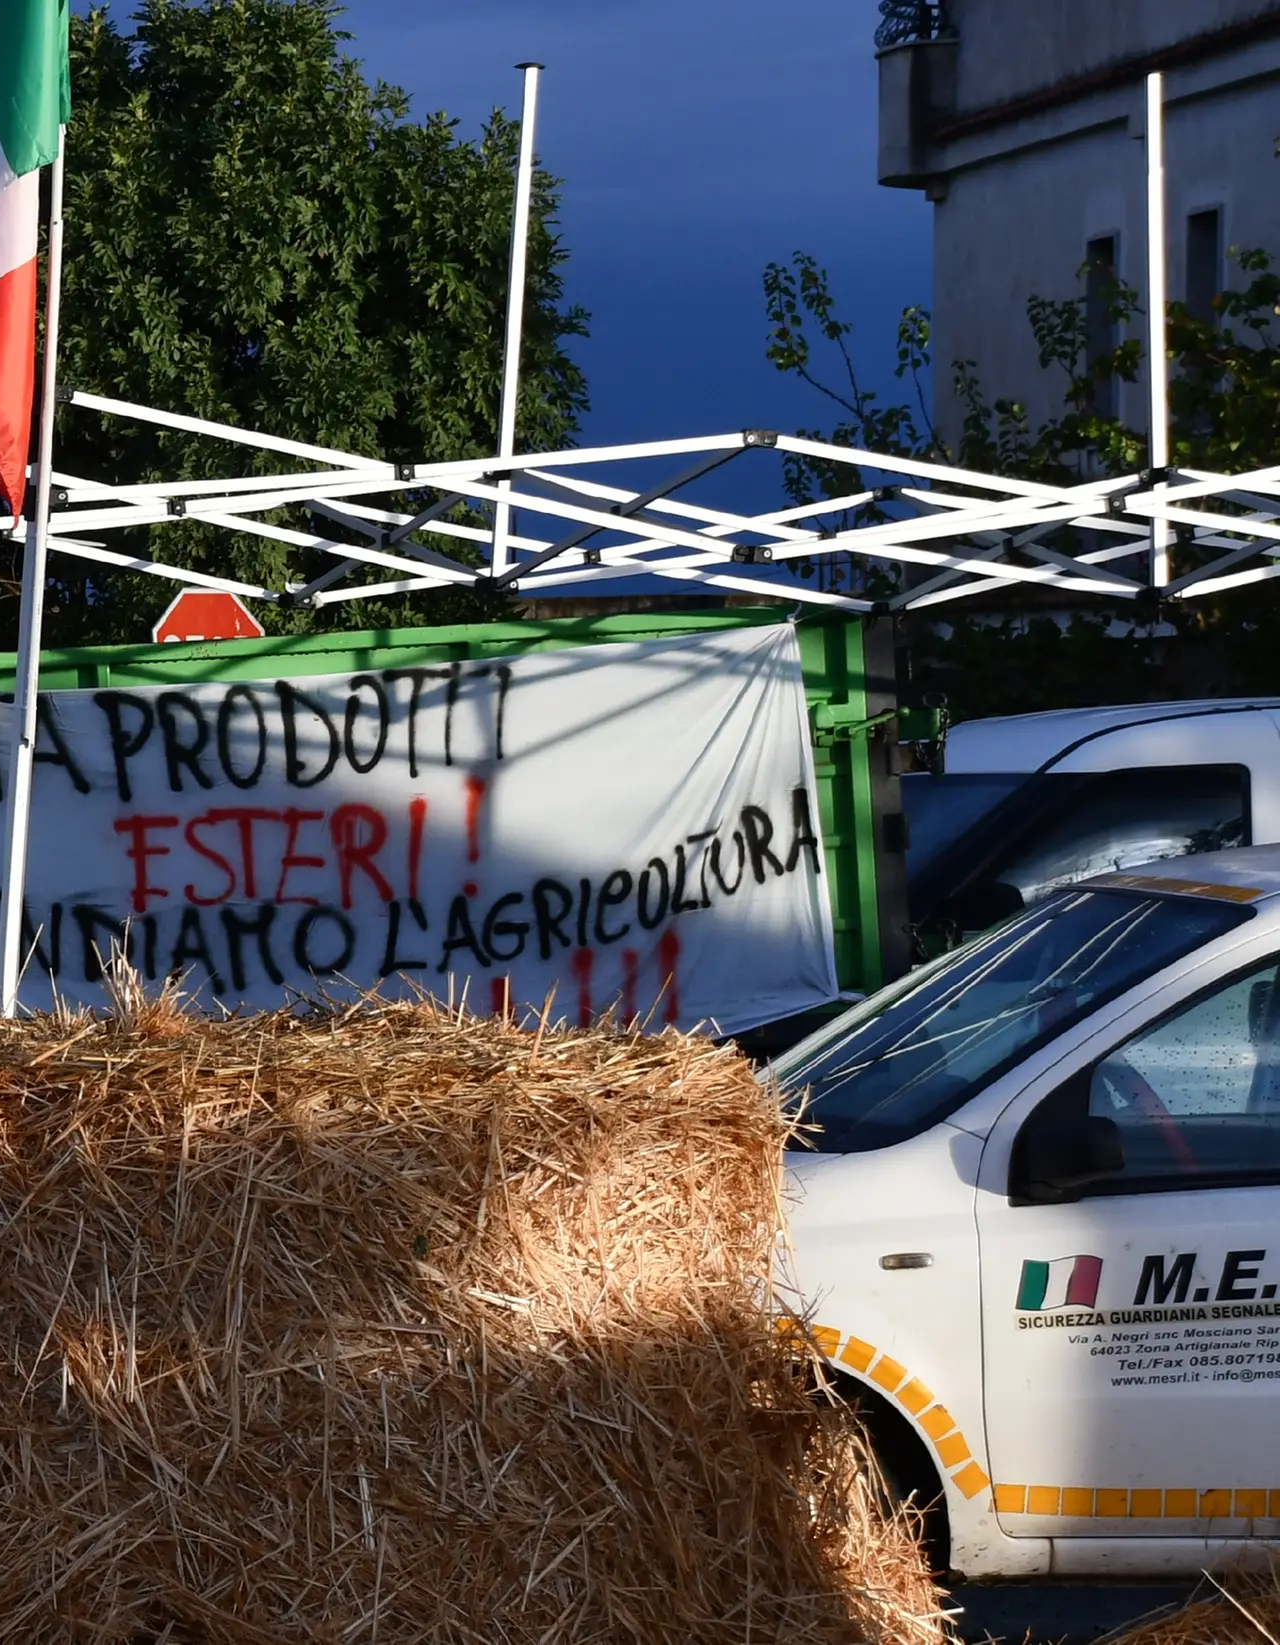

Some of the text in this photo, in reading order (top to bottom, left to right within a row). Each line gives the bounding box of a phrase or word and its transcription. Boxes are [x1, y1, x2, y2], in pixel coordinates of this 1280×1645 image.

[93, 664, 511, 802] PRODOTTI
[379, 787, 821, 978] L'AGRICOLTURA
[1133, 1250, 1278, 1306] M.E.
[1018, 1313, 1105, 1330] SICUREZZA
[1110, 1307, 1207, 1325] GUARDIANIA
[1068, 1335, 1089, 1344] Via
[1093, 1334, 1107, 1343] A.
[1112, 1331, 1149, 1344] Negri
[1154, 1331, 1179, 1340] snc
[1183, 1327, 1252, 1338] Mosciano
[1090, 1345, 1131, 1356] 64023
[1135, 1344, 1170, 1353] Zona
[1174, 1340, 1251, 1352] Artigianale
[1118, 1358, 1183, 1371] Tel./Fax
[1111, 1371, 1200, 1387] www.mesrl.it
